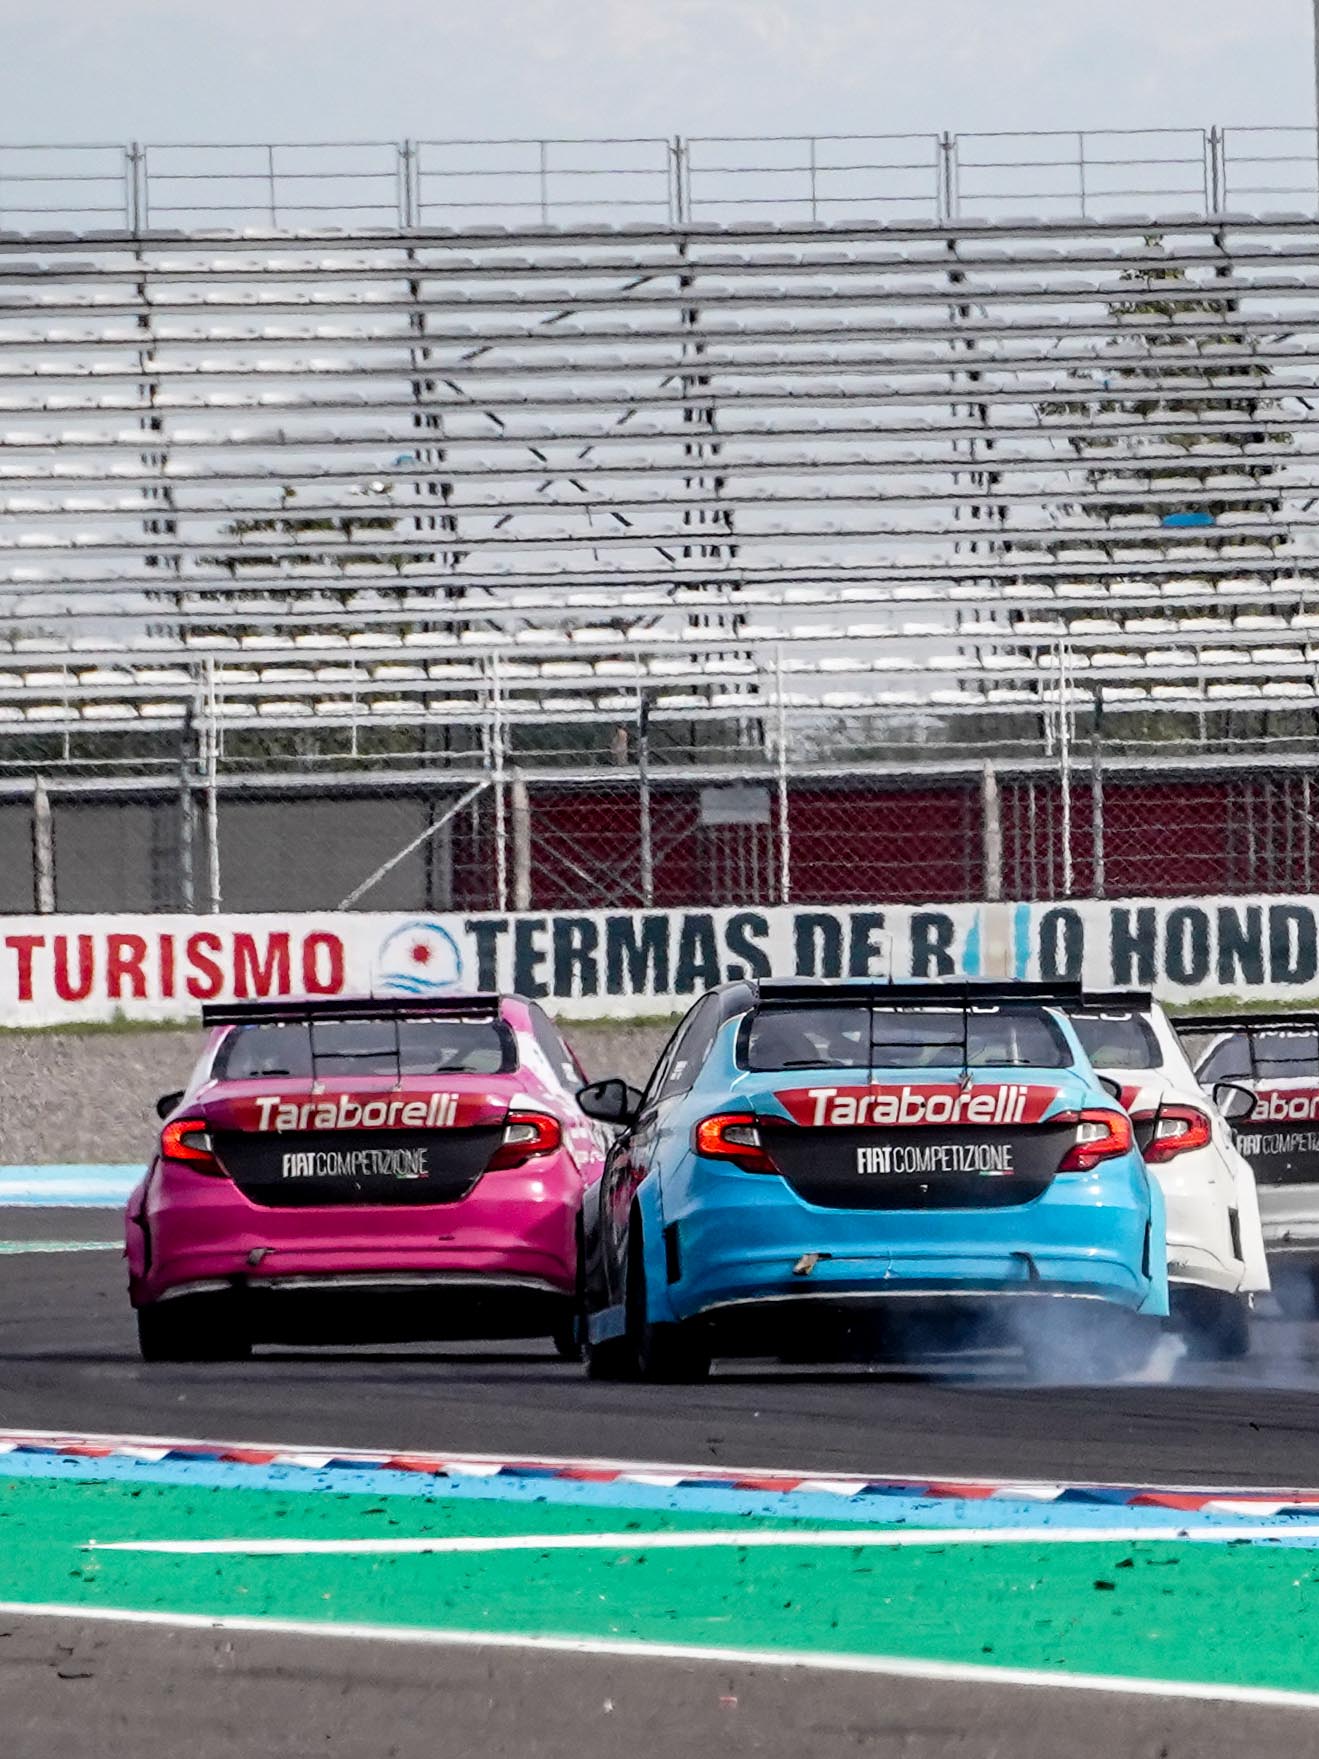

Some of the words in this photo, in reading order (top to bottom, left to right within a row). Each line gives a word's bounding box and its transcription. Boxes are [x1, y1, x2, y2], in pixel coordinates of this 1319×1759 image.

[5, 931, 344, 1002] TURISMO
[464, 912, 773, 999] TERMAS
[794, 912, 886, 978] DE
[255, 1092, 460, 1132] Taraborelli
[808, 1085, 1028, 1127] Taraborelli
